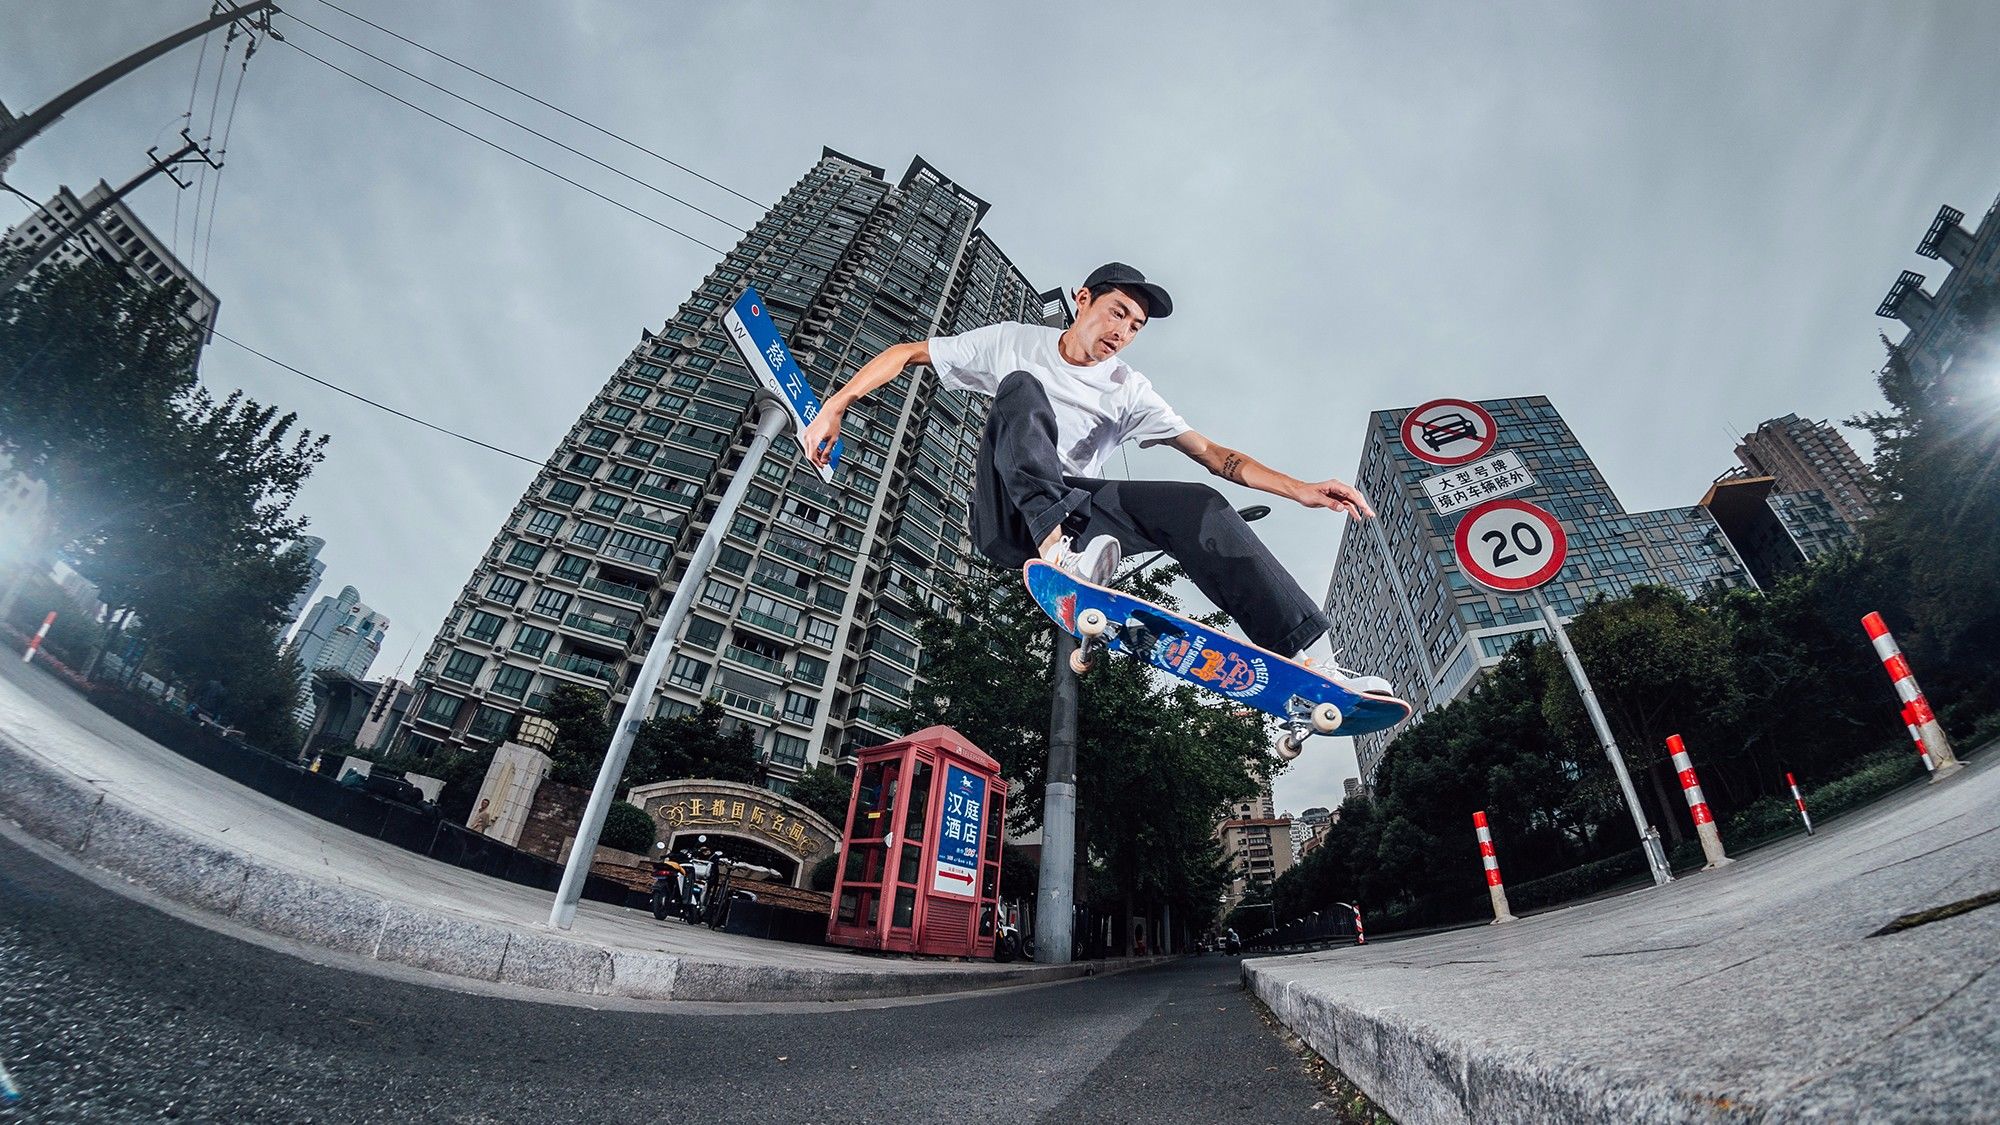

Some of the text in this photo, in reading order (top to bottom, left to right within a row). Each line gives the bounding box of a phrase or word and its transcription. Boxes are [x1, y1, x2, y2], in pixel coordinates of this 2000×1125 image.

[733, 321, 747, 340] W
[1437, 470, 1524, 508] 境内车辆除外
[1438, 459, 1508, 491] 大型号牌
[1481, 521, 1543, 568] 20
[1250, 657, 1269, 685] STREET
[689, 798, 805, 841] 亚都国际名园
[947, 791, 980, 822] 汉庭
[944, 815, 978, 845] 酒店
